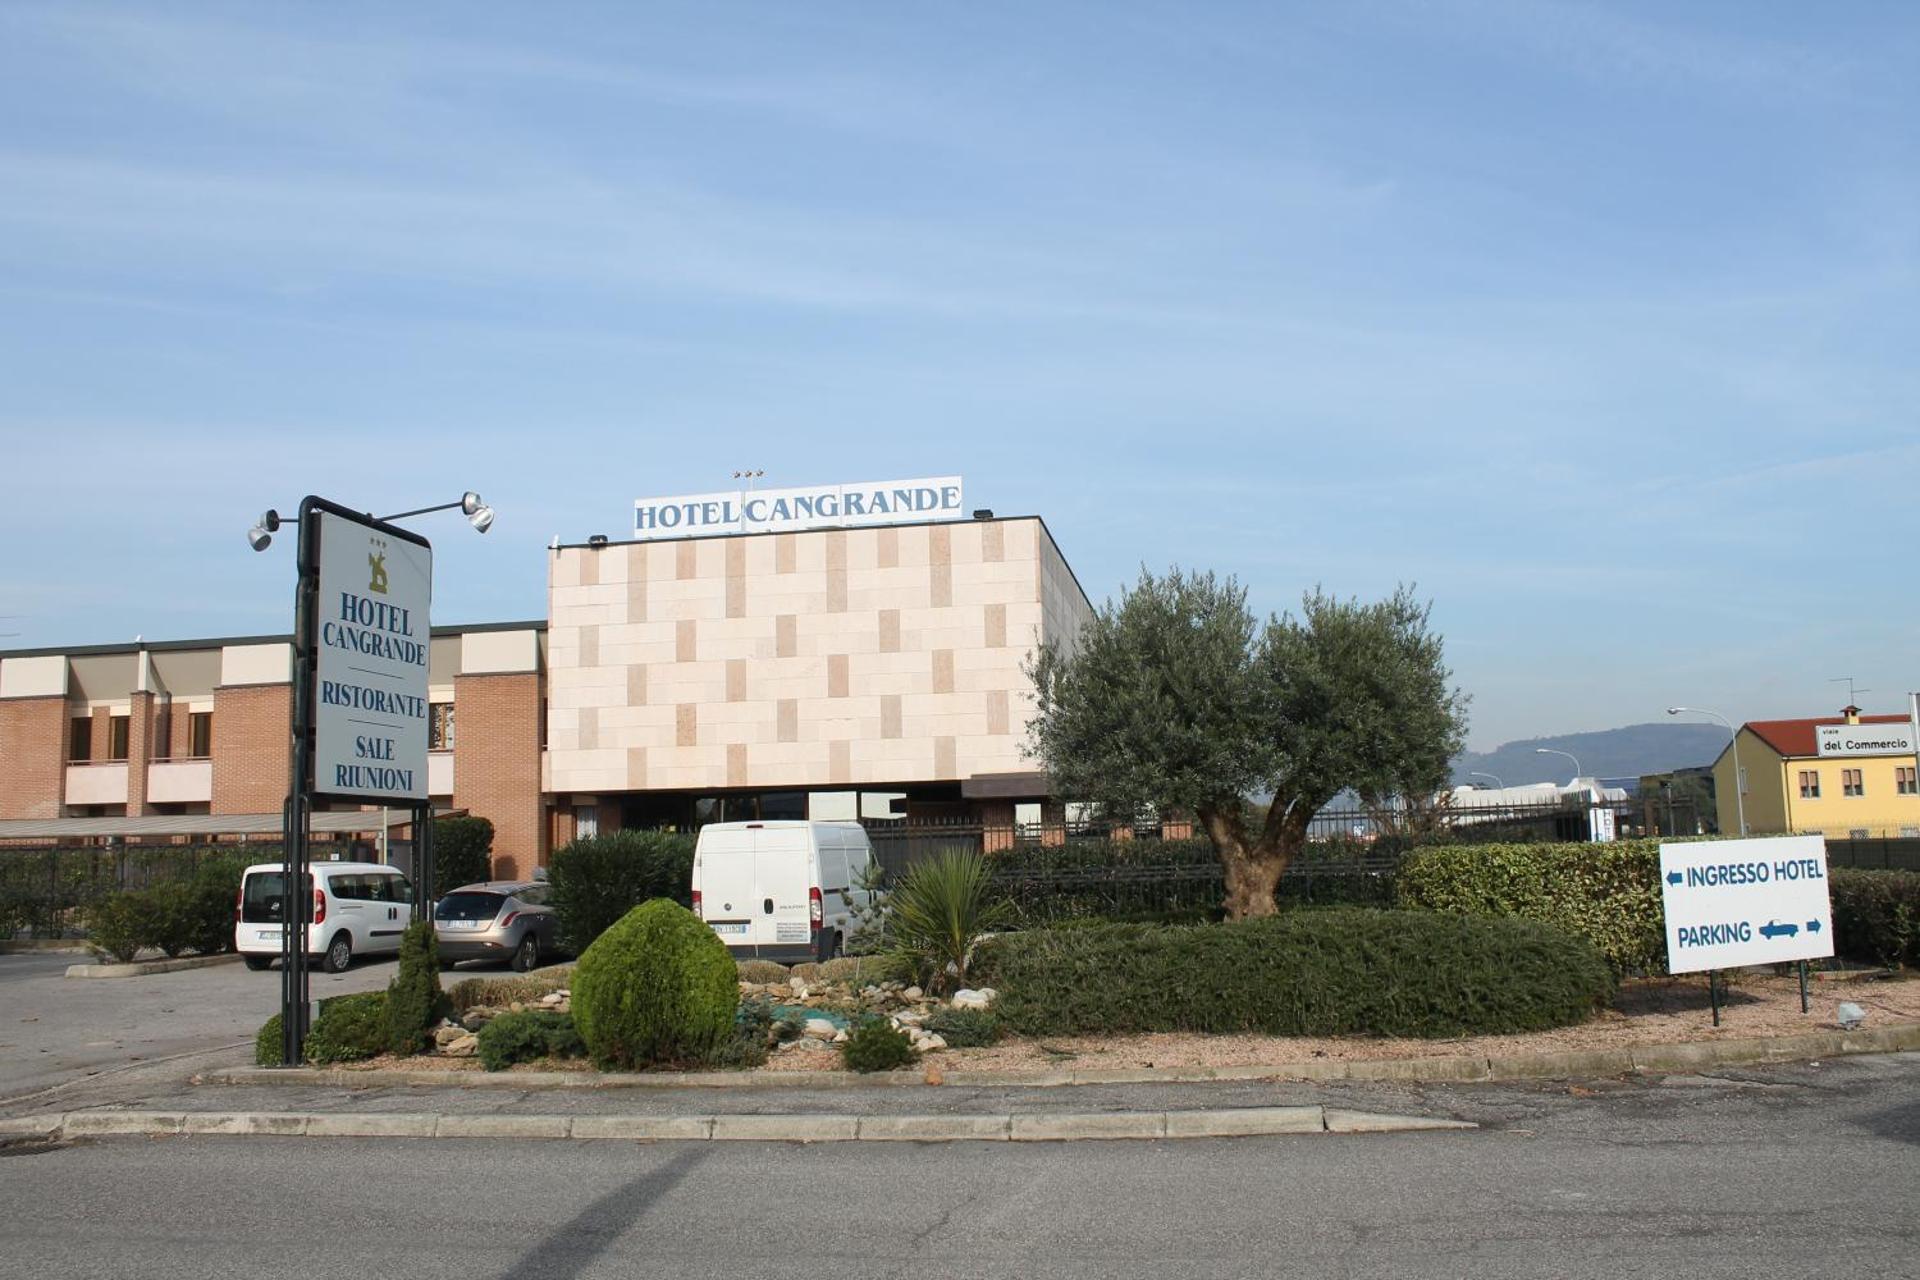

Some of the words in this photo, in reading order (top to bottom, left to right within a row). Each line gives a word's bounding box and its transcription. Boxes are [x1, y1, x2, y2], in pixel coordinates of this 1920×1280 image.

[635, 501, 741, 529] HOTEL
[745, 486, 961, 522] CANGRANDE
[341, 592, 413, 636] HOTEL
[323, 622, 426, 666] CANGRANDE
[322, 681, 426, 719] RISTORANTE
[355, 735, 395, 761] SALE
[1824, 740, 1842, 750] del
[1846, 738, 1908, 750] Commercio
[336, 764, 413, 791] RIUNIONI
[1687, 862, 1769, 887] INGRESSO
[1774, 859, 1823, 881] HOTEL
[1678, 921, 1752, 948] PARKING
